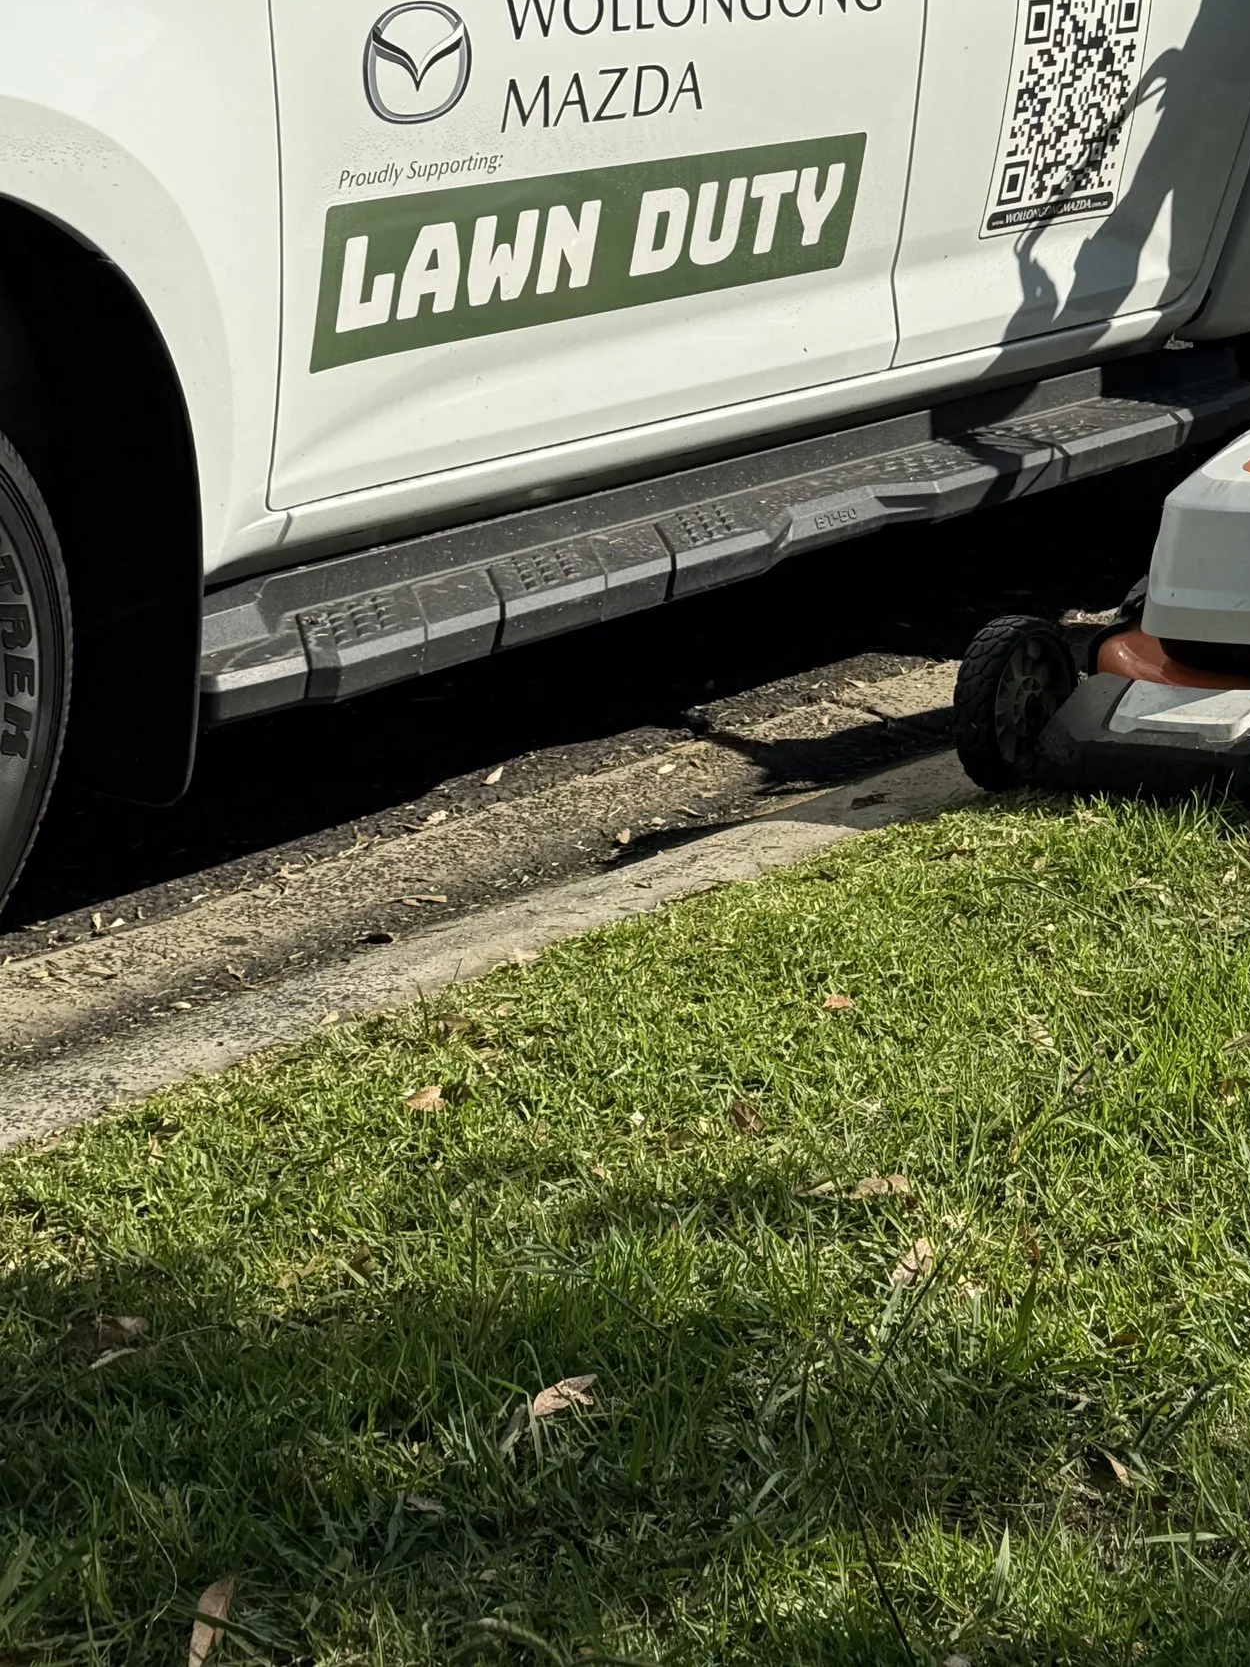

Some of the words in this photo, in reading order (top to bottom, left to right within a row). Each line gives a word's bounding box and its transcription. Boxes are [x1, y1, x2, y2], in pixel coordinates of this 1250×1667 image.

[501, 61, 703, 133] MAZDA
[339, 163, 404, 189] Proudly
[407, 152, 504, 182] Supporting:
[335, 200, 602, 334] LAWN
[629, 163, 846, 277] DUTY
